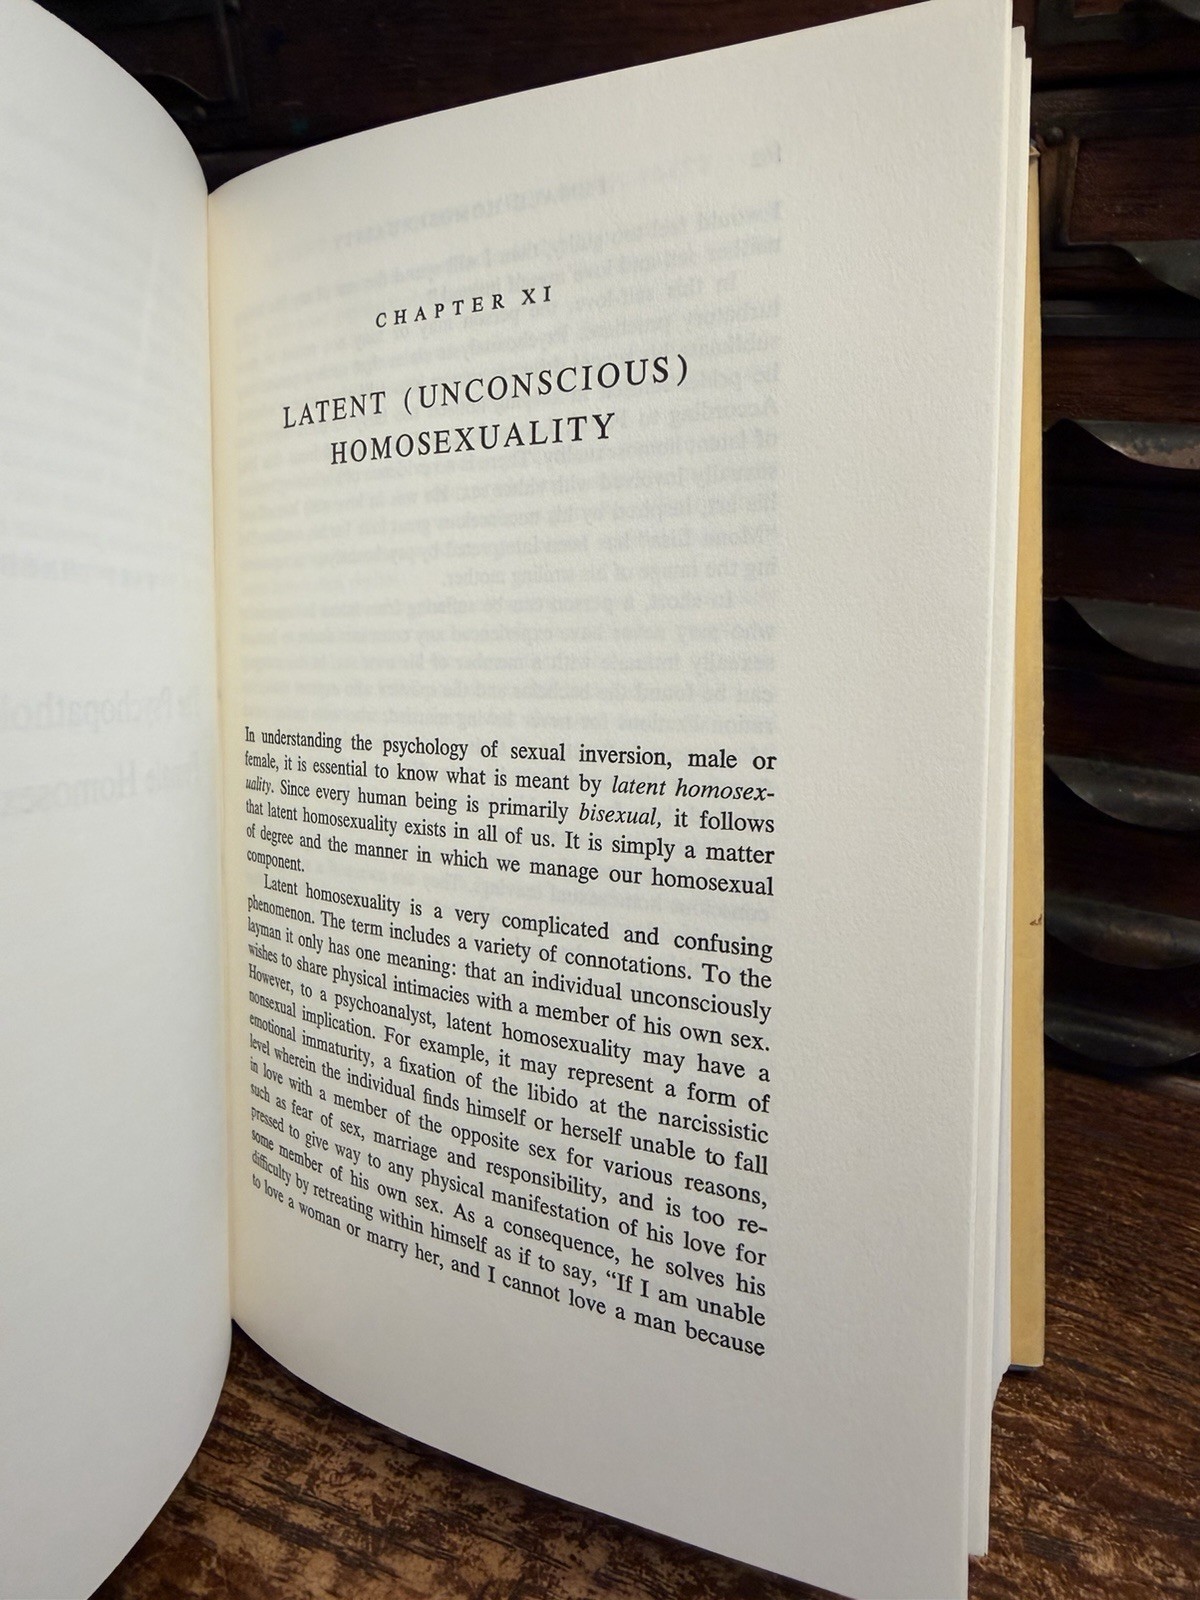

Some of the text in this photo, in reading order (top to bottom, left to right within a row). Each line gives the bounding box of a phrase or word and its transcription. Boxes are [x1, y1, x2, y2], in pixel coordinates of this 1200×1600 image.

[376, 286, 551, 328] CHAPTER XI
[283, 354, 687, 428] LATENT (UNCONSCIOUS)
[331, 412, 615, 465] HOMOSEXUALITY
[245, 726, 777, 770] In understanding the psychology of sexual inversion, male or
[245, 750, 774, 801] female, it is essential to know what is meant by latent homosex-
[246, 776, 774, 833] uality. Since every human being is primarily bisexual, it follows
[246, 799, 775, 864] that latent homosexuality exists in all of us. It is simply a matter
[247, 823, 774, 896] of degree and the manner in which we manage our homosexual
[247, 850, 304, 872] component.
[248, 894, 772, 988] phenomenon. The term includes a variety of connotations. To the
[264, 874, 773, 963] Latent homosexuality is a very complicated and confusing
[248, 916, 772, 1025] layman it only has one meaning: that an individual unconsciously
[249, 963, 770, 1082] However, to a psychoanalyst, latent homosexuality may have a
[250, 1014, 768, 1144] emotional immaturity, a fixation of the libido at the narcissistic
[250, 1056, 766, 1210] in love with a member of the opposite sex for various reasons,
[252, 1107, 766, 1266] pressed to give way to any physical manifestation of his love for
[253, 1174, 765, 1356] to love a woman or marry her, and I cannot love a man because
